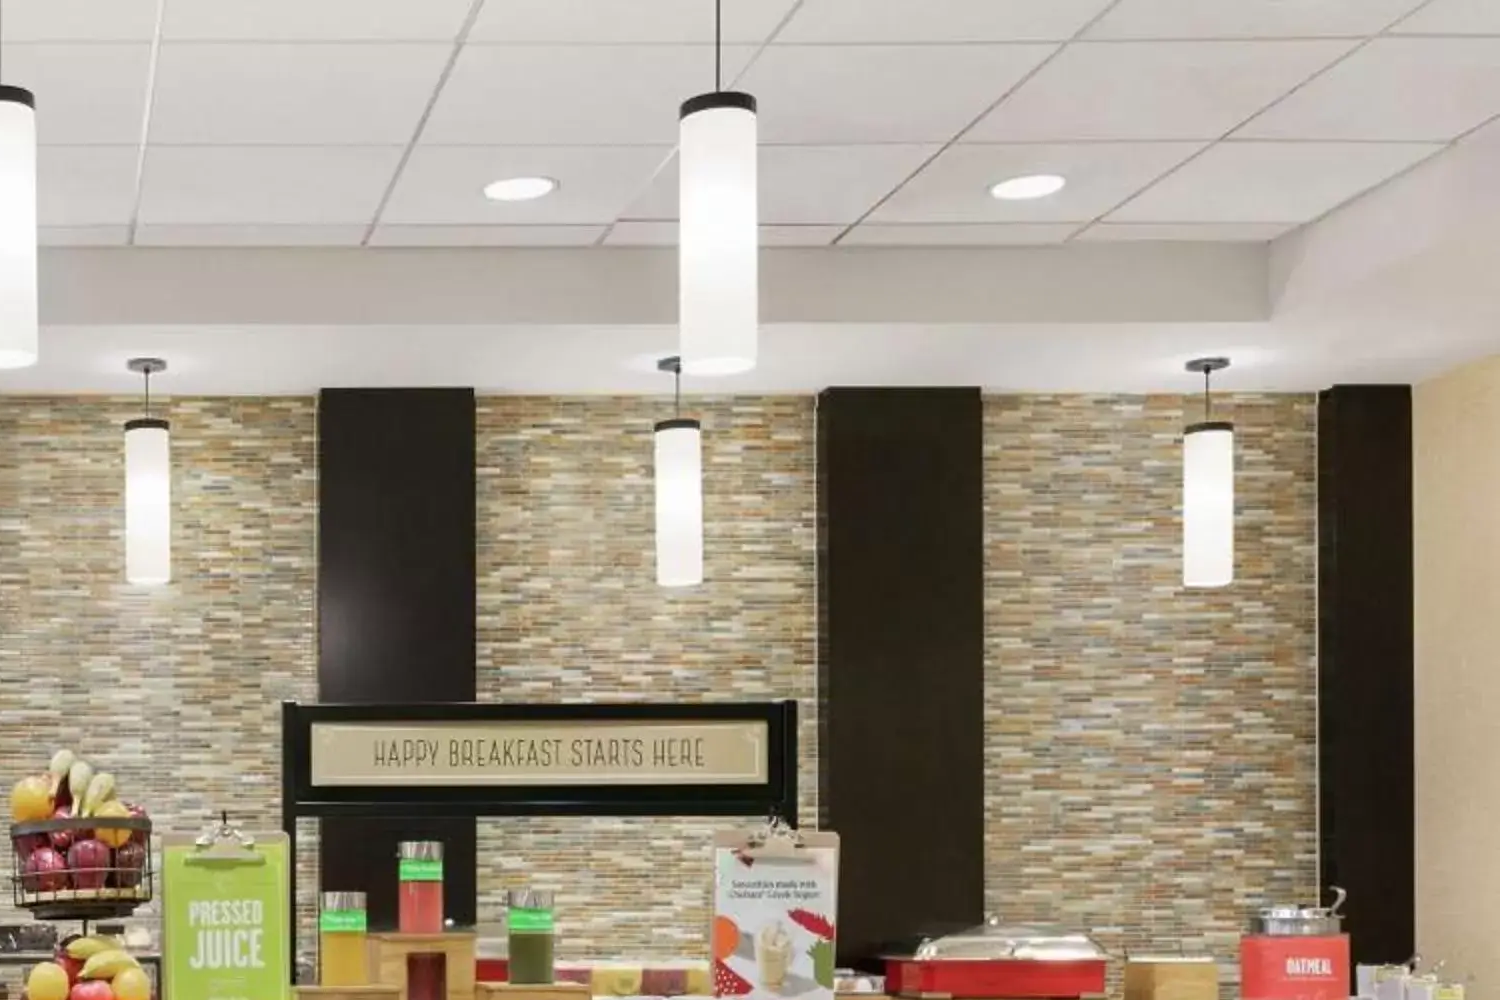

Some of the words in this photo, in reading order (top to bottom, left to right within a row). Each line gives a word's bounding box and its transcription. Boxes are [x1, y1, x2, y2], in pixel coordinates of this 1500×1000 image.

[373, 739, 439, 768] HAPPY
[449, 738, 562, 768] BREAKFAST
[571, 738, 644, 768] STARTS
[653, 737, 705, 767] HERE
[188, 899, 264, 927] PRESSED
[188, 928, 266, 970] JUICE
[1285, 957, 1333, 976] OATMEAL
